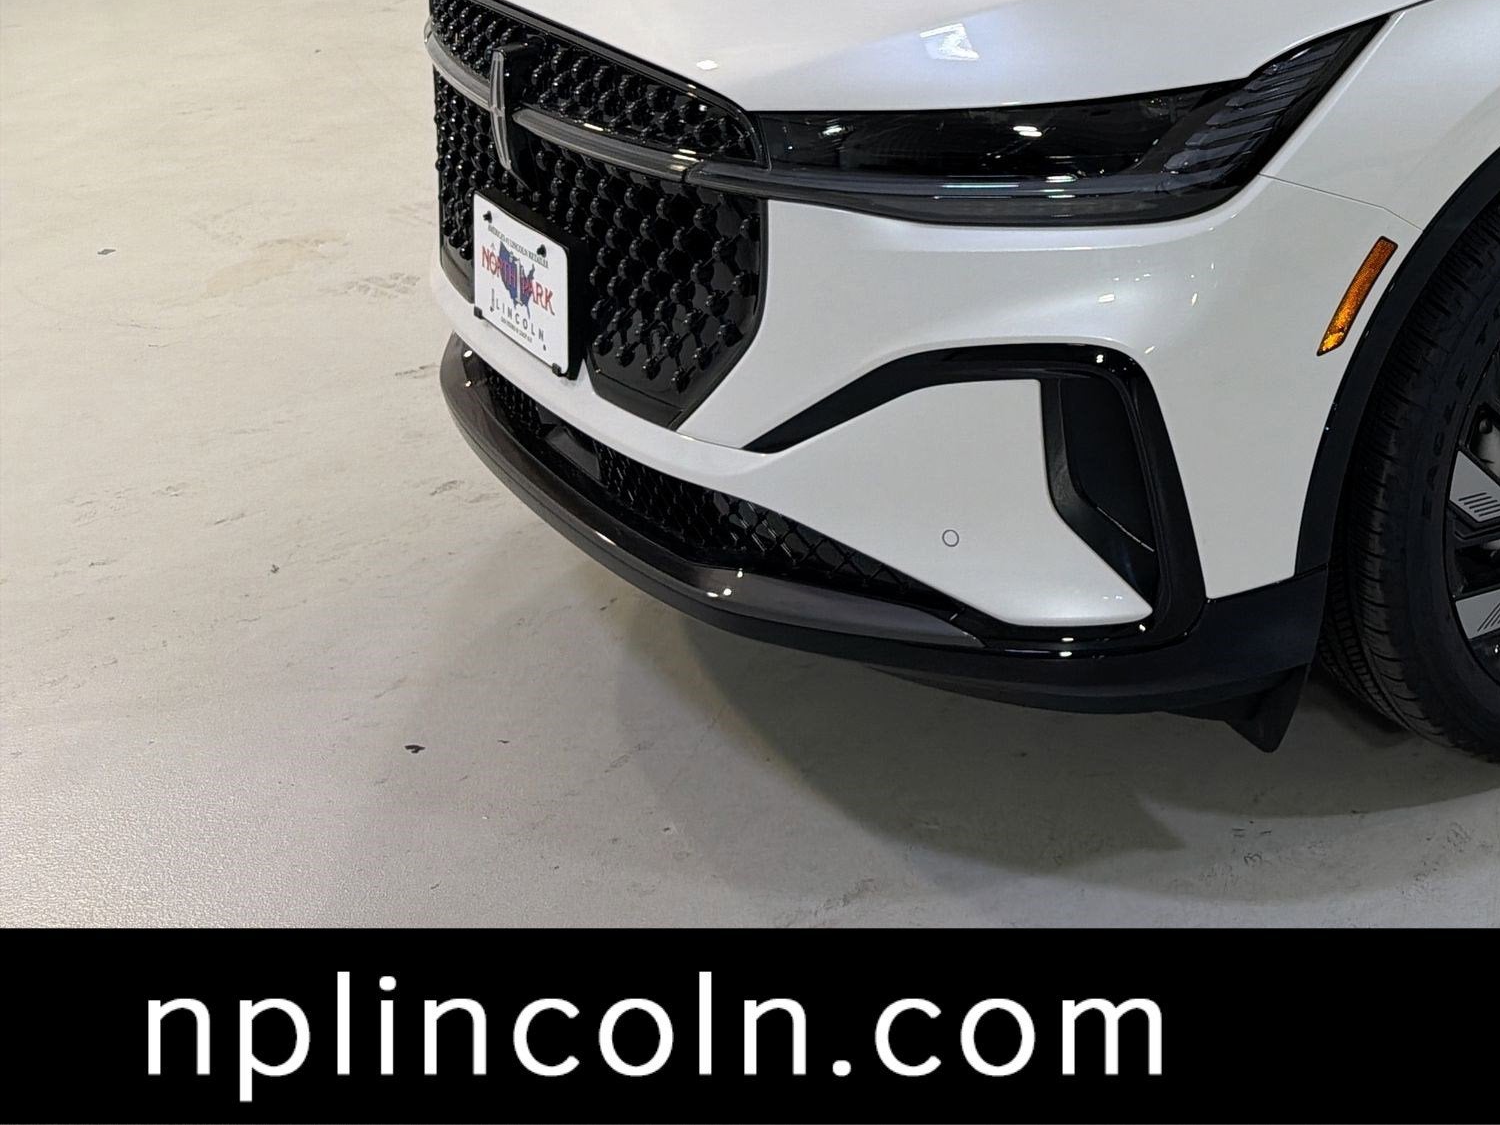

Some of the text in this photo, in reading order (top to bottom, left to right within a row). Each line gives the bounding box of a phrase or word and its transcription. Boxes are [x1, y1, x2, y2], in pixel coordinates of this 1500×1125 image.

[481, 245, 556, 316] NORTH PARK
[496, 298, 545, 341] LINCOLN
